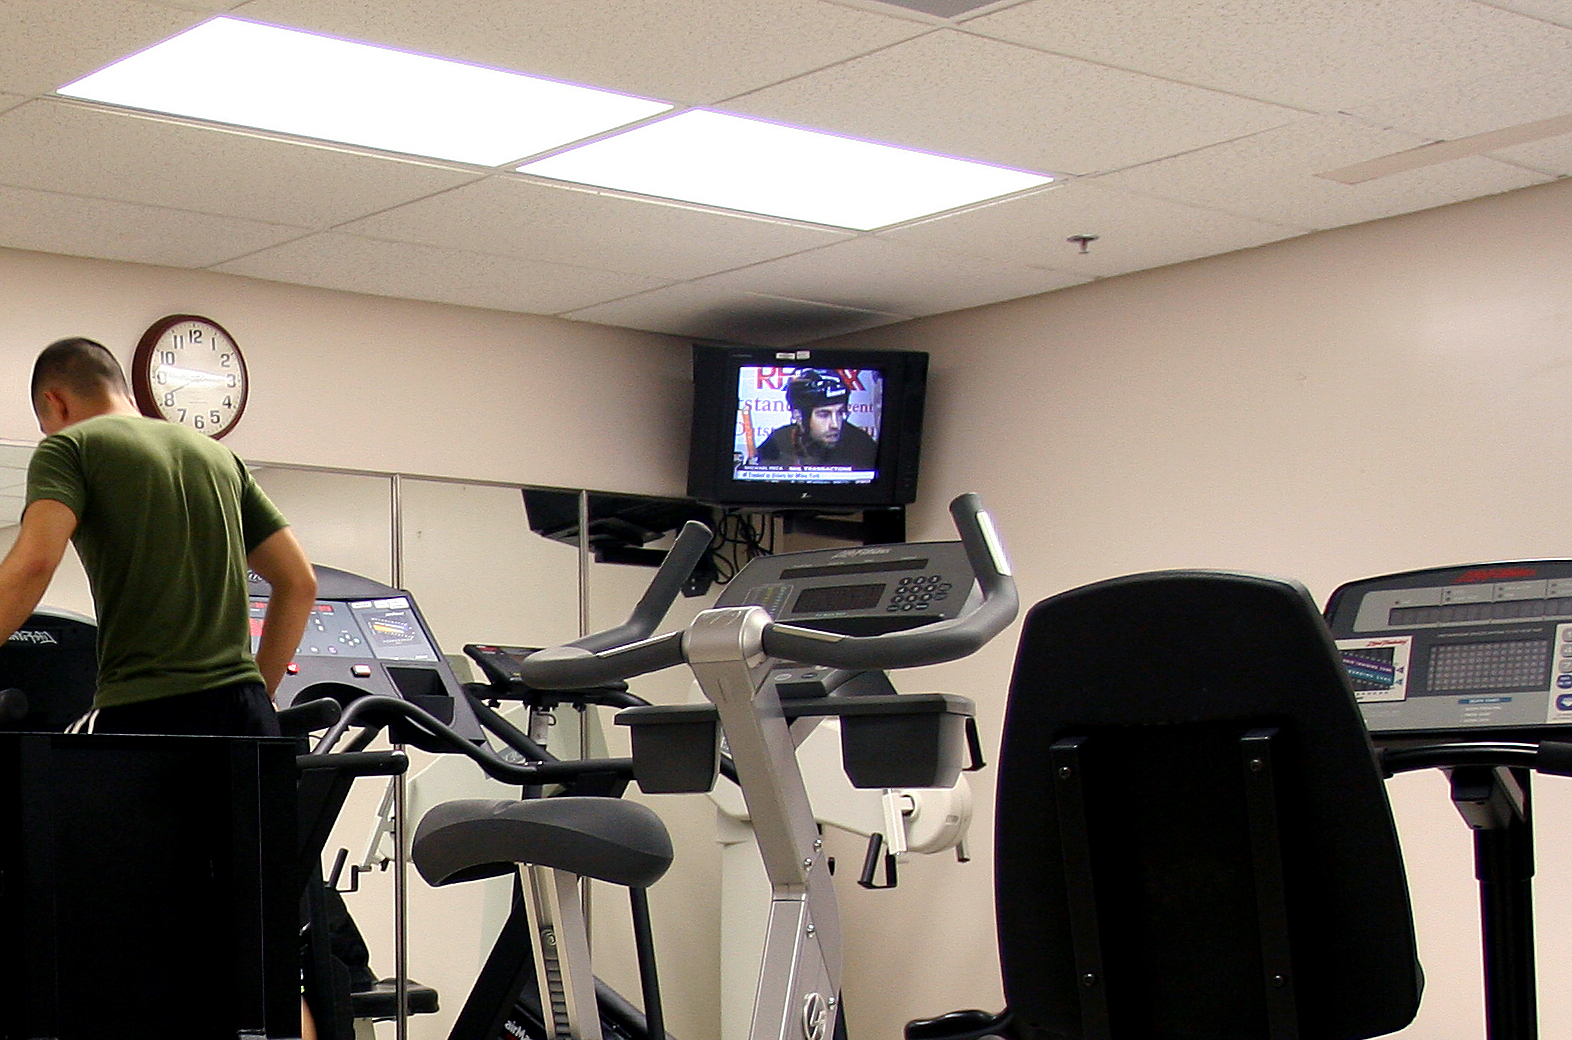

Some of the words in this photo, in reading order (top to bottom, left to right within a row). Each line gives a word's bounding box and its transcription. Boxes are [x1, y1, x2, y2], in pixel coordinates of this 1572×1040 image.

[173, 335, 184, 349] 11
[189, 329, 202, 343] 12
[211, 337, 216, 350] 1
[160, 351, 175, 365] 10
[221, 353, 230, 367] 2
[226, 374, 236, 388] 3
[164, 392, 174, 407] 8
[222, 395, 232, 409] 4
[177, 408, 186, 422] 7
[195, 414, 204, 429] 6
[210, 410, 220, 424] 5
